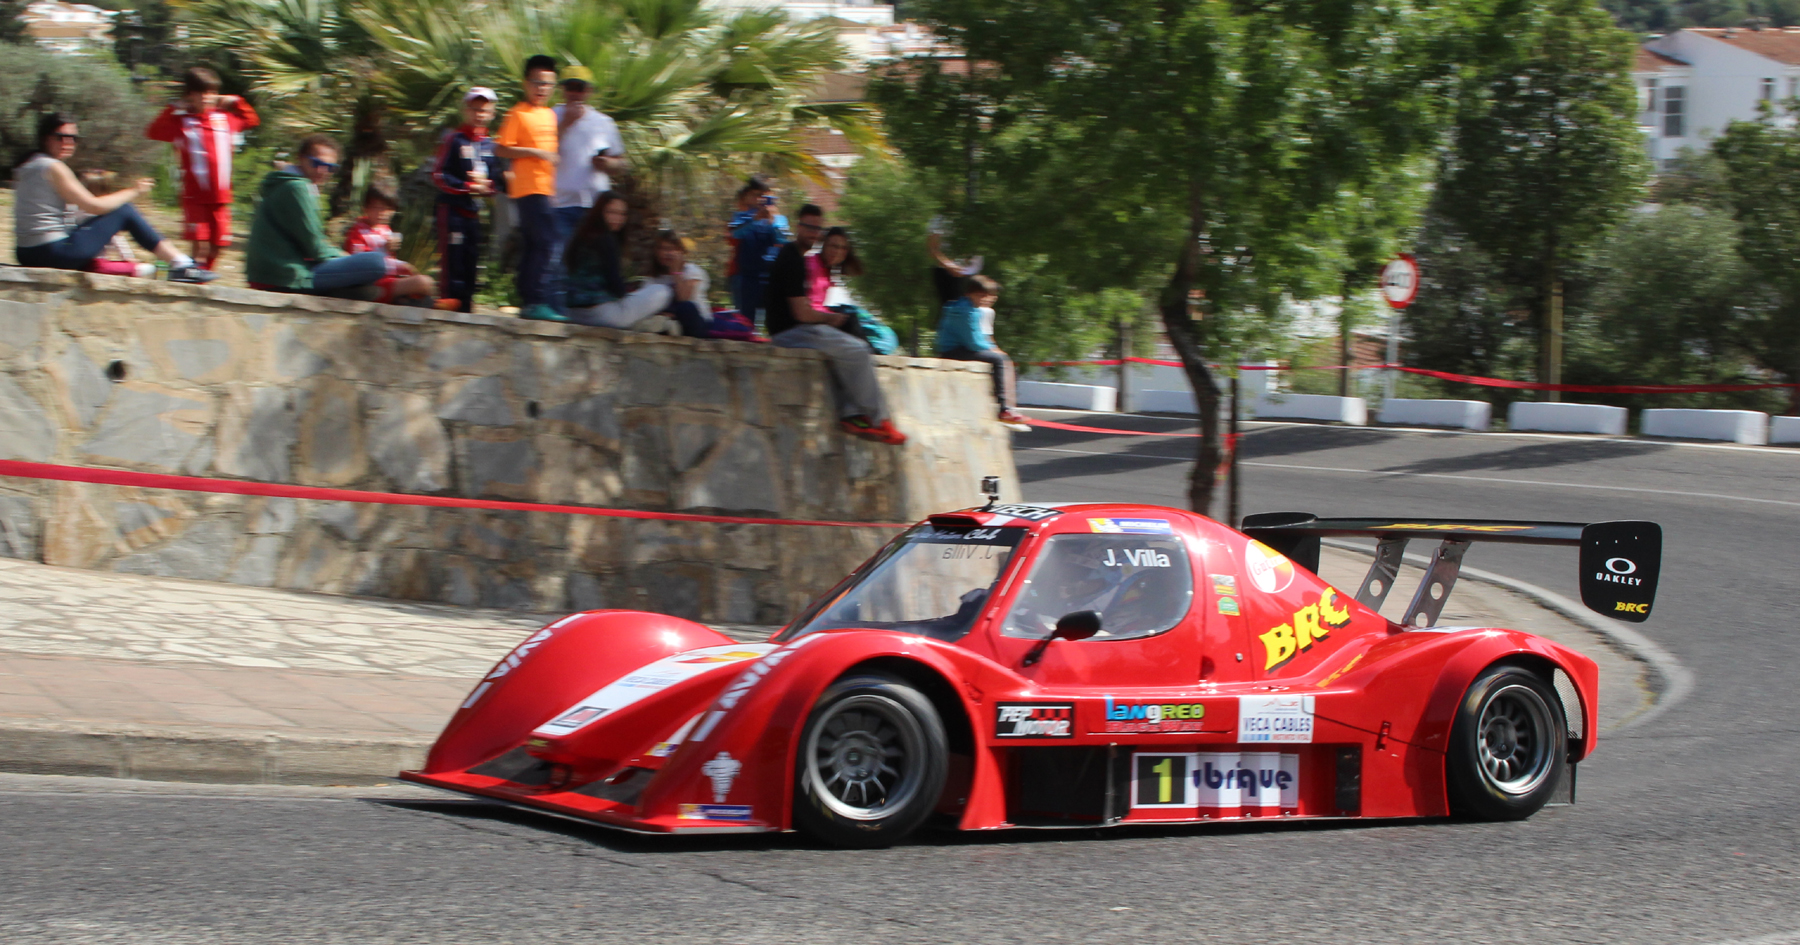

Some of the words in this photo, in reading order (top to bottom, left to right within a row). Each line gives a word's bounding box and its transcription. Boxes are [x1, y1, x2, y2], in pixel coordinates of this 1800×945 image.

[1103, 548, 1123, 567] J.
[1123, 548, 1171, 567] Villa
[1595, 572, 1642, 587] OAKLEY
[1614, 601, 1649, 614] BRC
[1258, 586, 1351, 672] BRC
[998, 708, 1034, 722] PEP
[1013, 720, 1071, 734] MOTOR
[1243, 717, 1271, 731] VECA
[1274, 717, 1311, 731] CABLES
[1152, 758, 1172, 803] 1
